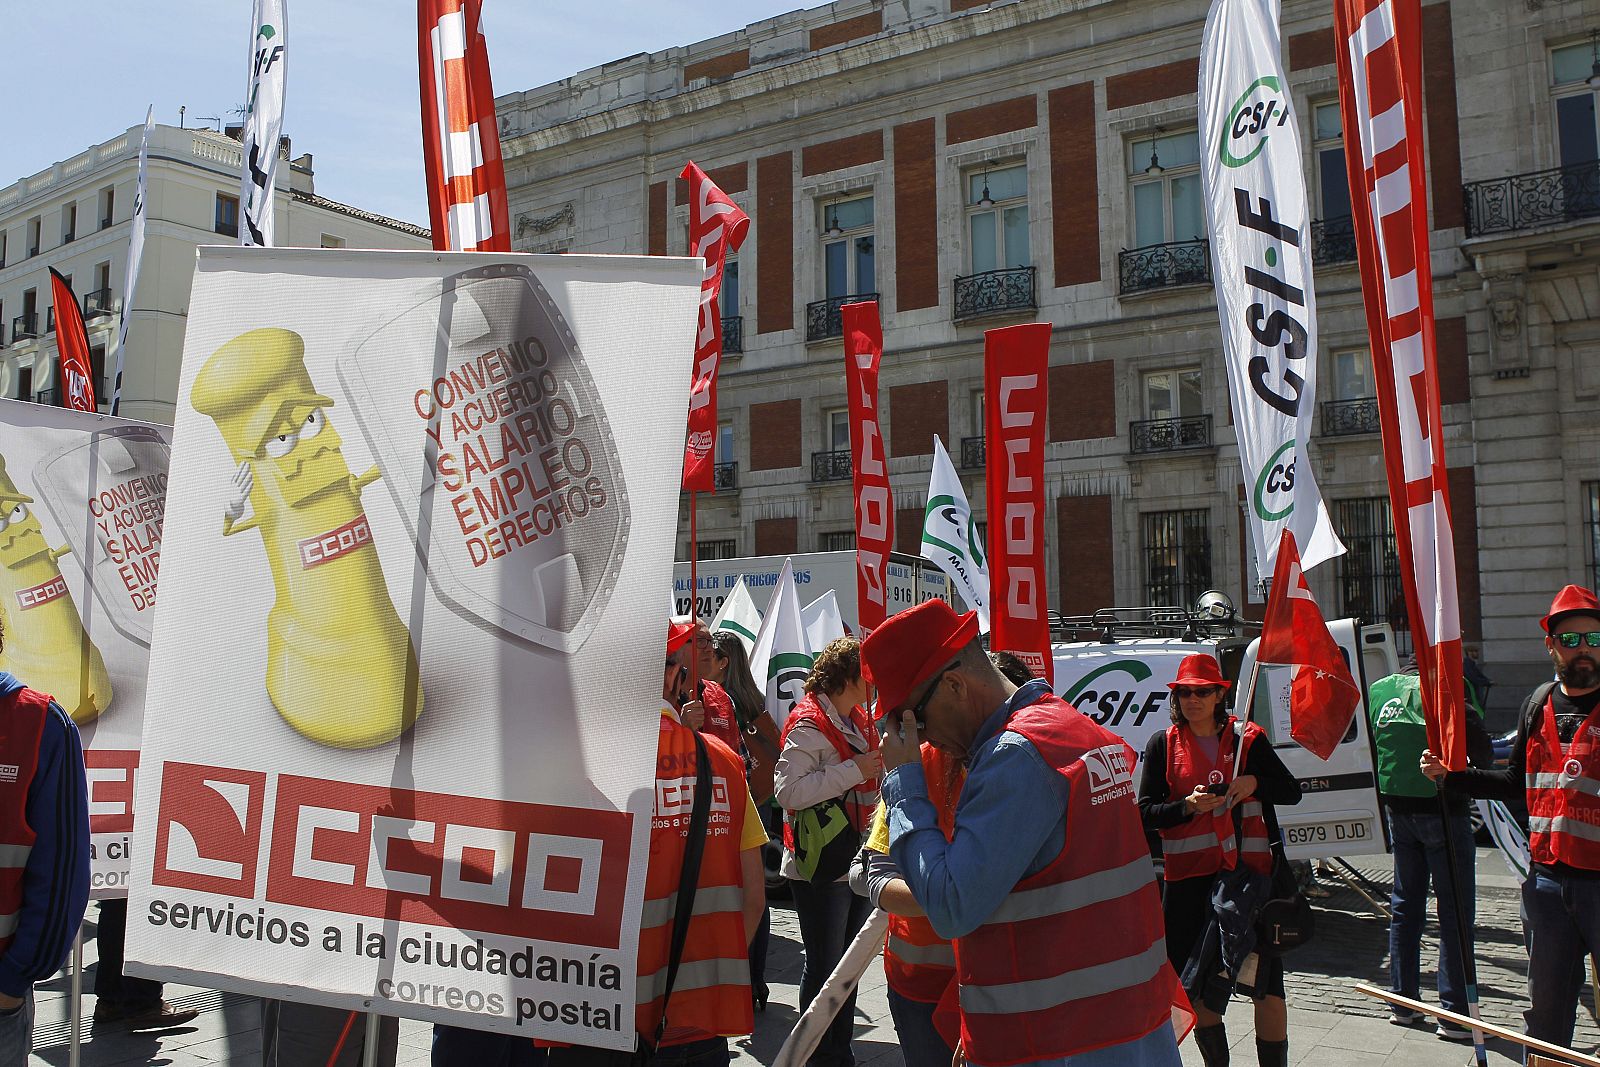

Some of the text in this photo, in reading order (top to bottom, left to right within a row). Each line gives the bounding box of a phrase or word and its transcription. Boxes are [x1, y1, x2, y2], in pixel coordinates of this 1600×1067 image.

[414, 337, 548, 420] CONVENIO
[425, 369, 559, 450] Y ACUERDO
[437, 399, 575, 491] SALARIO
[452, 438, 592, 535] EMPLEO
[466, 477, 607, 567] DERECHOS
[98, 519, 110, 537] Y
[303, 520, 370, 563] CCOO
[20, 580, 67, 606] CCOO
[894, 586, 911, 603] 916
[293, 804, 603, 915] CCOO
[1288, 822, 1365, 843] 6979 DJD
[148, 900, 621, 991] servicios a la ciudadanía
[377, 978, 621, 1032] correos postal
